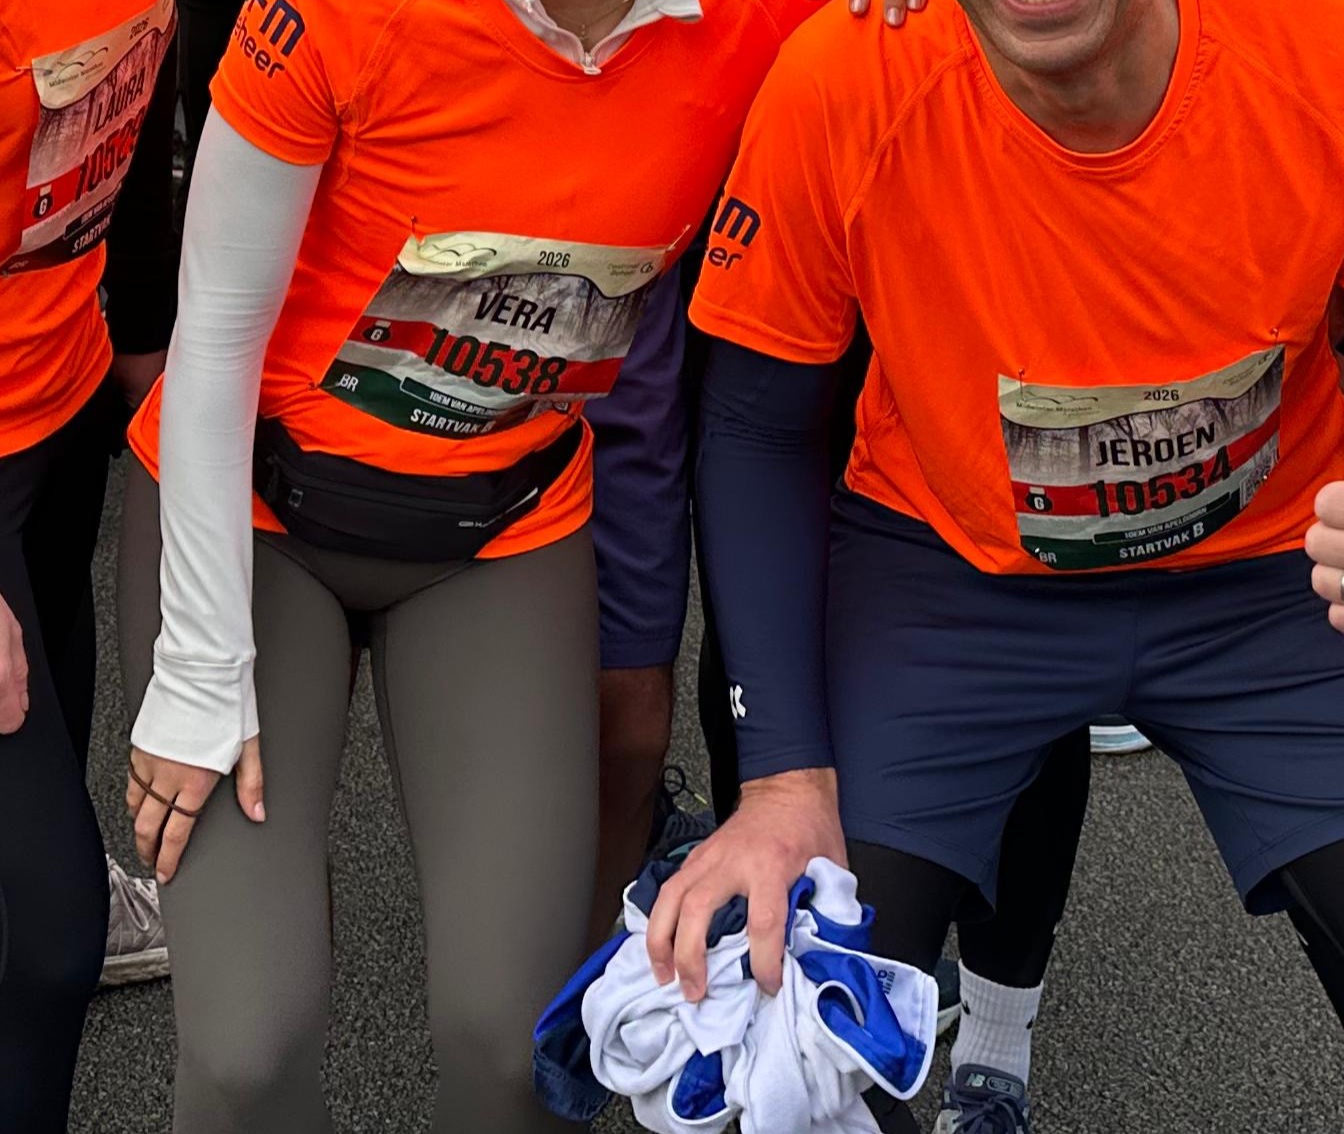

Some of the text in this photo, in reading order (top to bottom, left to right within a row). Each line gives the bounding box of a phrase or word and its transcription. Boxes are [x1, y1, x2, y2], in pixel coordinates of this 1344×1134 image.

[93, 65, 147, 135] LAURA
[537, 249, 572, 269] 2026
[473, 291, 557, 335] VERA
[423, 326, 569, 396] 10538
[339, 373, 360, 393] BR
[1143, 389, 1180, 403] 2026
[410, 408, 482, 434] STARTVAK
[1095, 422, 1216, 468] JEROEN
[1086, 444, 1234, 519] 10534
[1038, 551, 1058, 565] BR
[1118, 521, 1206, 560] STARTVAK B
